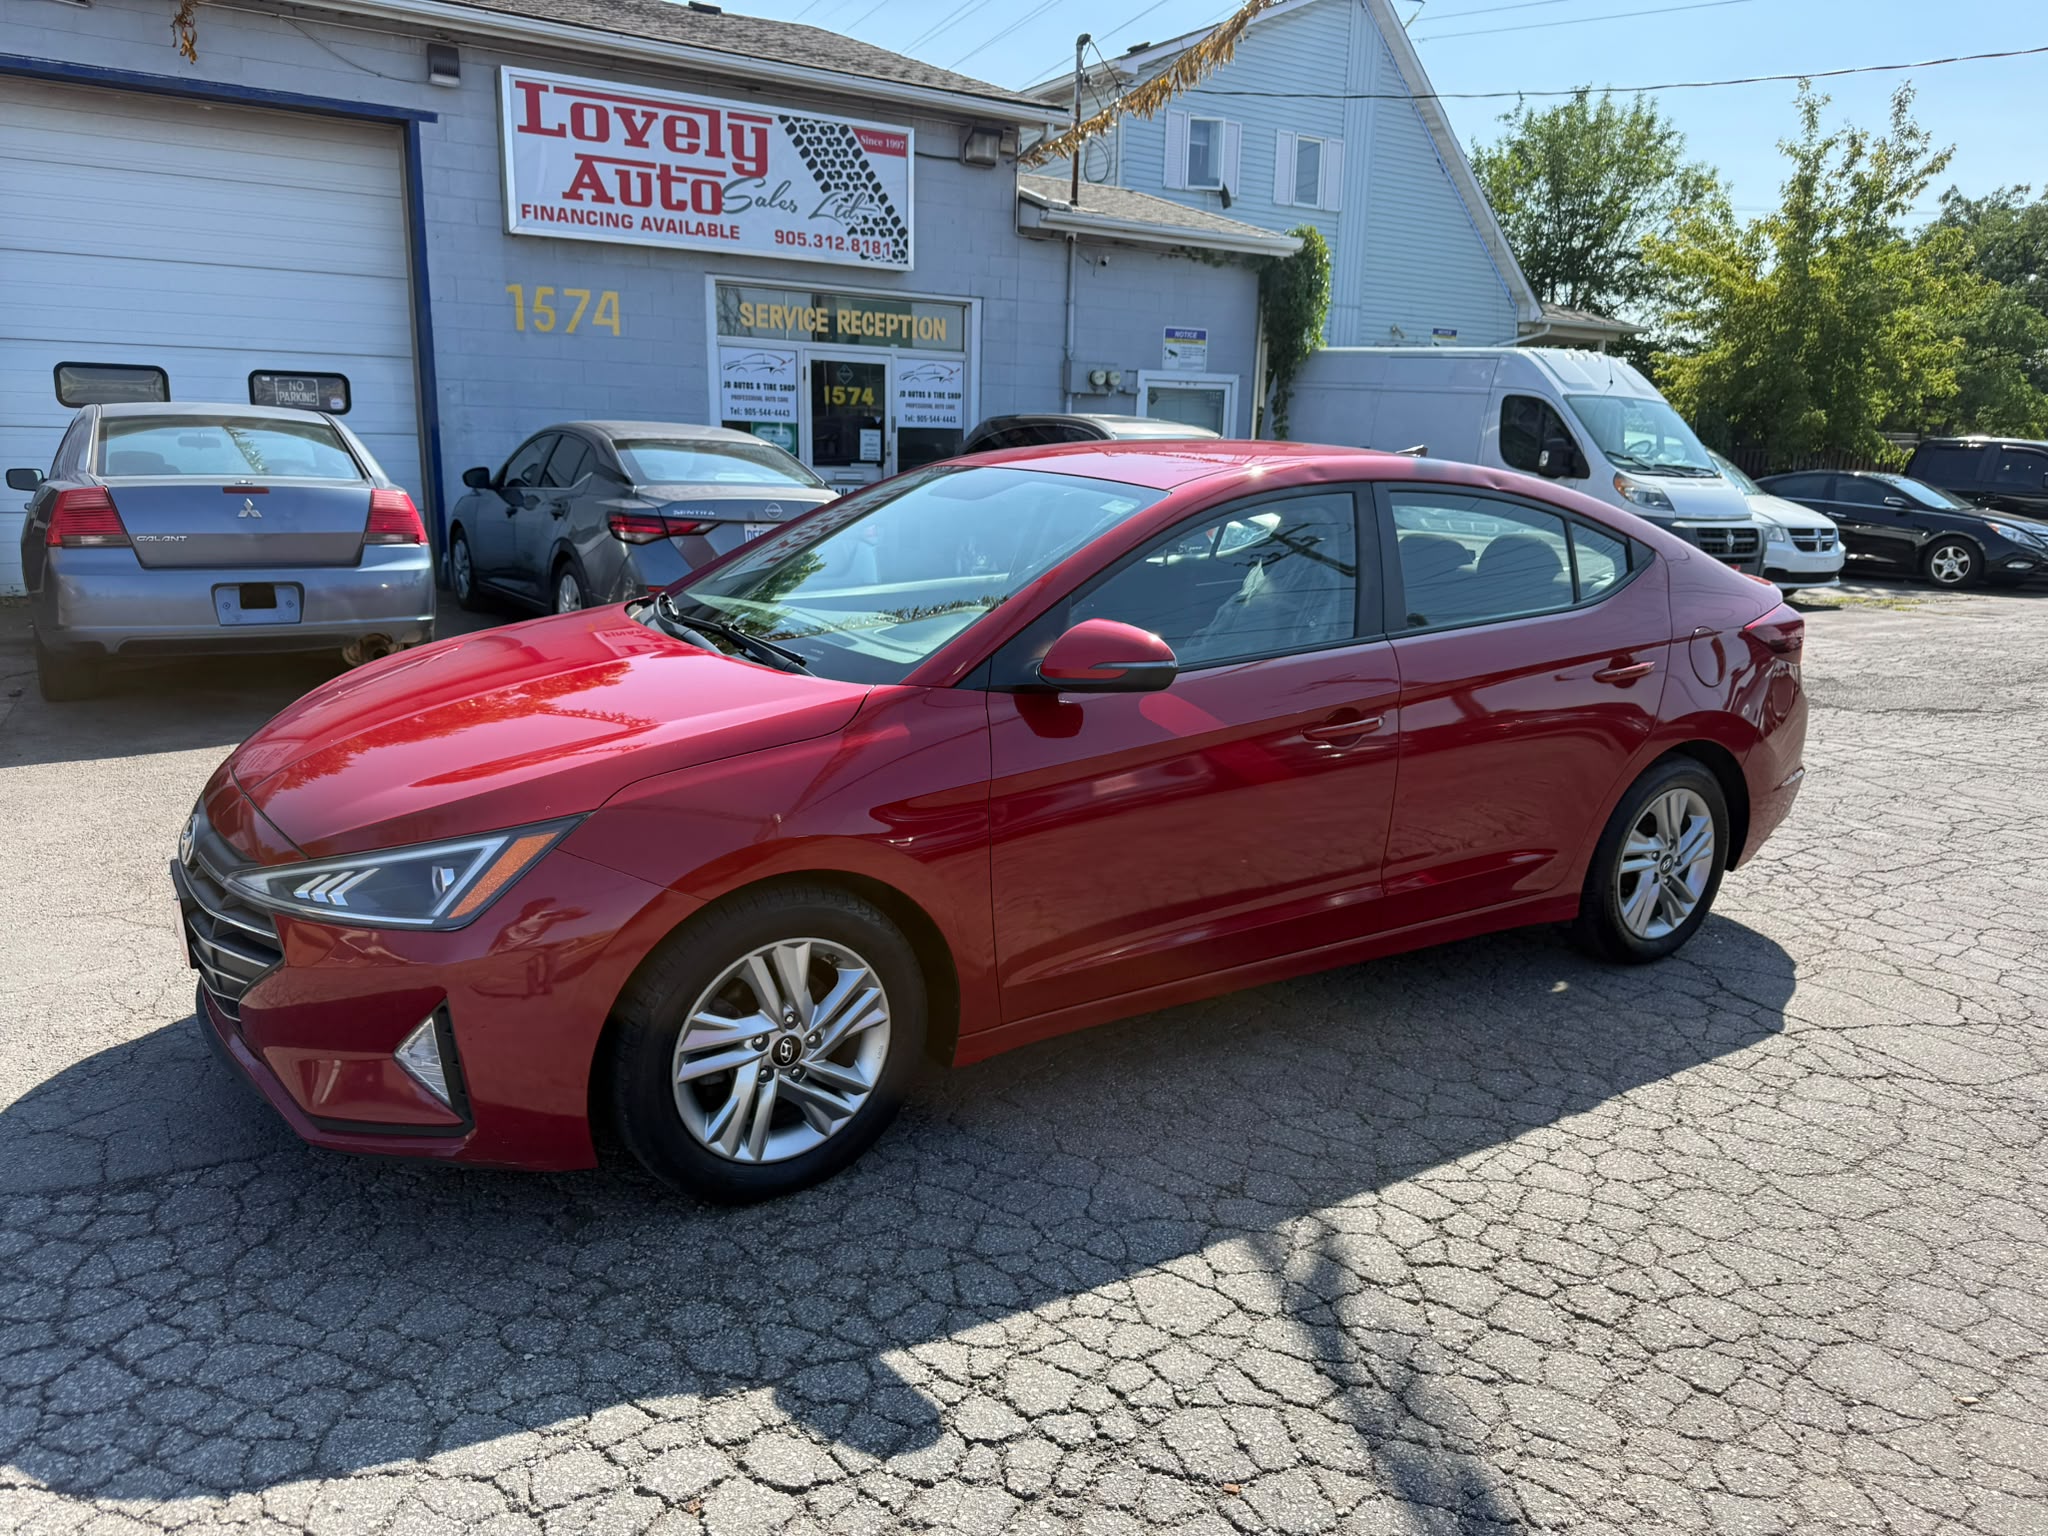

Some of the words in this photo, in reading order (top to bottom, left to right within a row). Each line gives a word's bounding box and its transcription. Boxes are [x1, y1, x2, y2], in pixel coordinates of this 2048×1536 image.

[515, 80, 770, 178] Lovely
[860, 135, 883, 147] Since
[885, 139, 905, 150] 1997
[562, 153, 725, 216] Auto
[721, 177, 798, 214] Sales
[521, 203, 634, 230] FINANCING
[640, 216, 740, 240] AVAILABLE
[774, 229, 891, 256] 905.312.8181
[505, 284, 620, 336] 1574
[739, 303, 829, 333] SERVICE
[837, 309, 947, 341] RECEPTION
[279, 391, 316, 403] PARKING
[288, 381, 304, 391] NO
[763, 383, 777, 391] TIRE
[779, 384, 796, 392] SHOP
[824, 385, 875, 406] 1574
[933, 391, 946, 399] TIRE
[730, 407, 742, 416] Tel:
[744, 407, 790, 417] 905-544-4443
